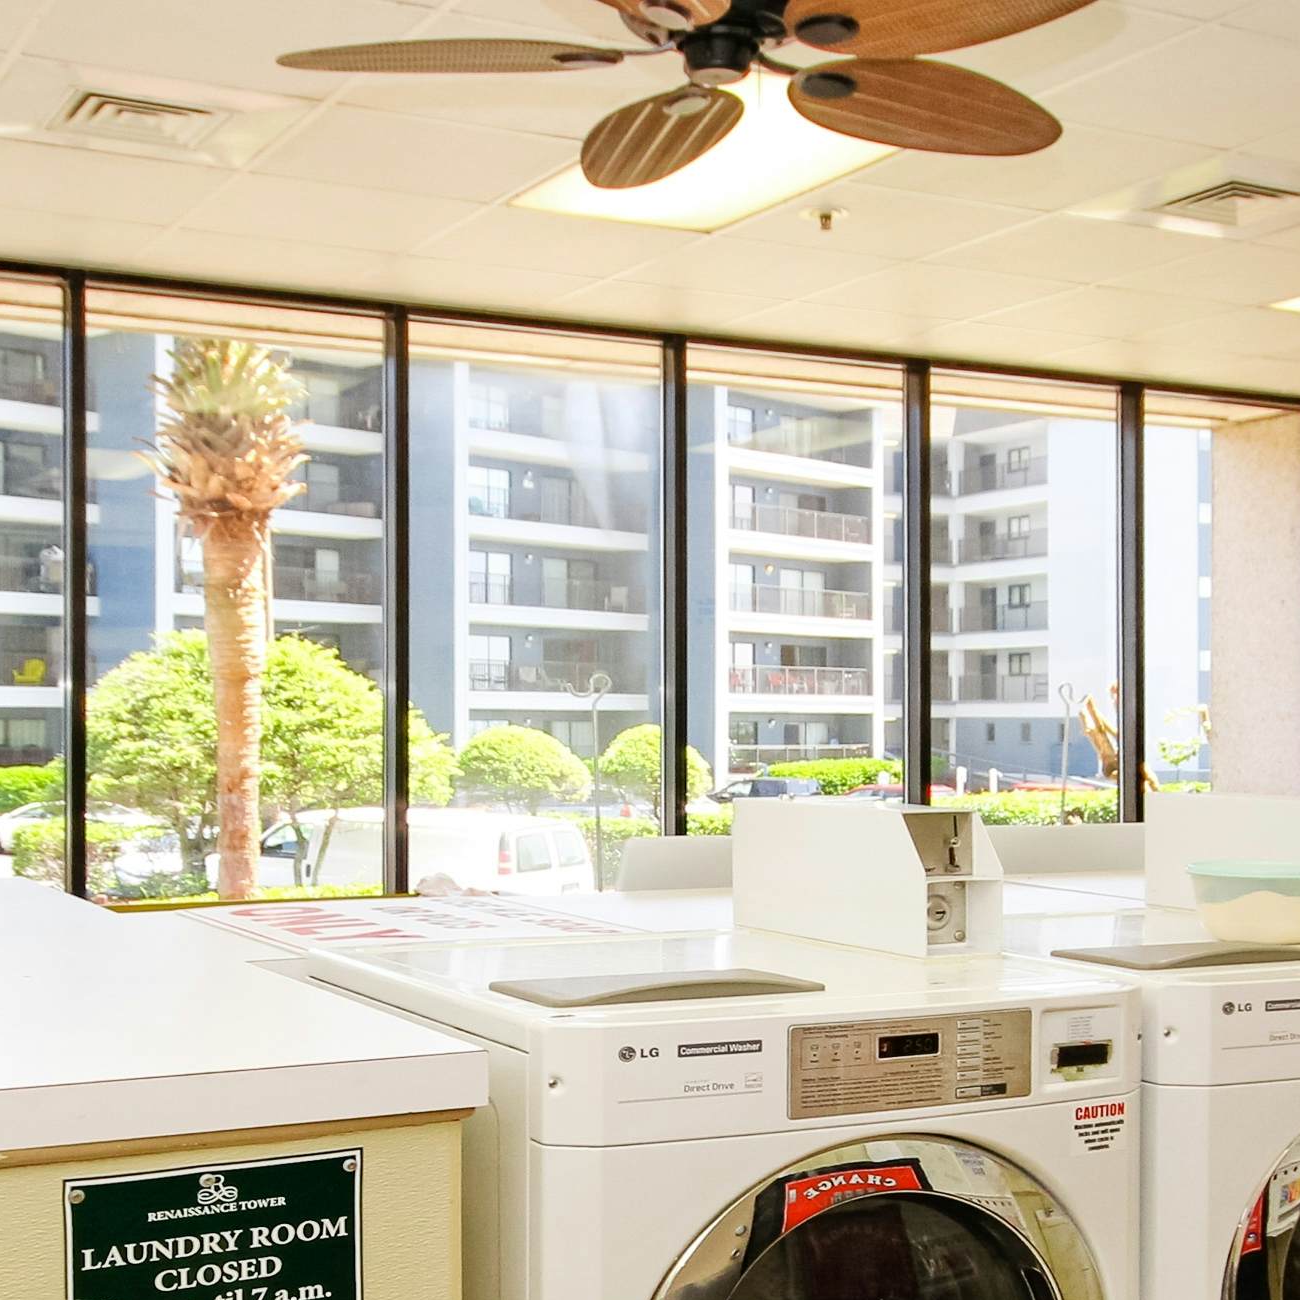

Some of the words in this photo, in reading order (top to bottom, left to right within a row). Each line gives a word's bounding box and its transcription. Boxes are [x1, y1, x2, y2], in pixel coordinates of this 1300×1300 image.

[229, 906, 429, 941] ONLY
[1237, 1003, 1252, 1012] LG
[640, 1047, 660, 1058] LG
[680, 1044, 728, 1056] Commercial
[729, 1042, 761, 1052] Washer
[684, 1082, 710, 1093] Direct
[712, 1081, 735, 1091] Drive
[1075, 1102, 1125, 1121] CAUTION
[147, 1202, 238, 1223] RENAISSANCE
[238, 1196, 287, 1212] TOWER
[81, 1229, 243, 1272] LAUNDRY
[250, 1216, 349, 1249] ROOM
[154, 1255, 283, 1293] CLOSED
